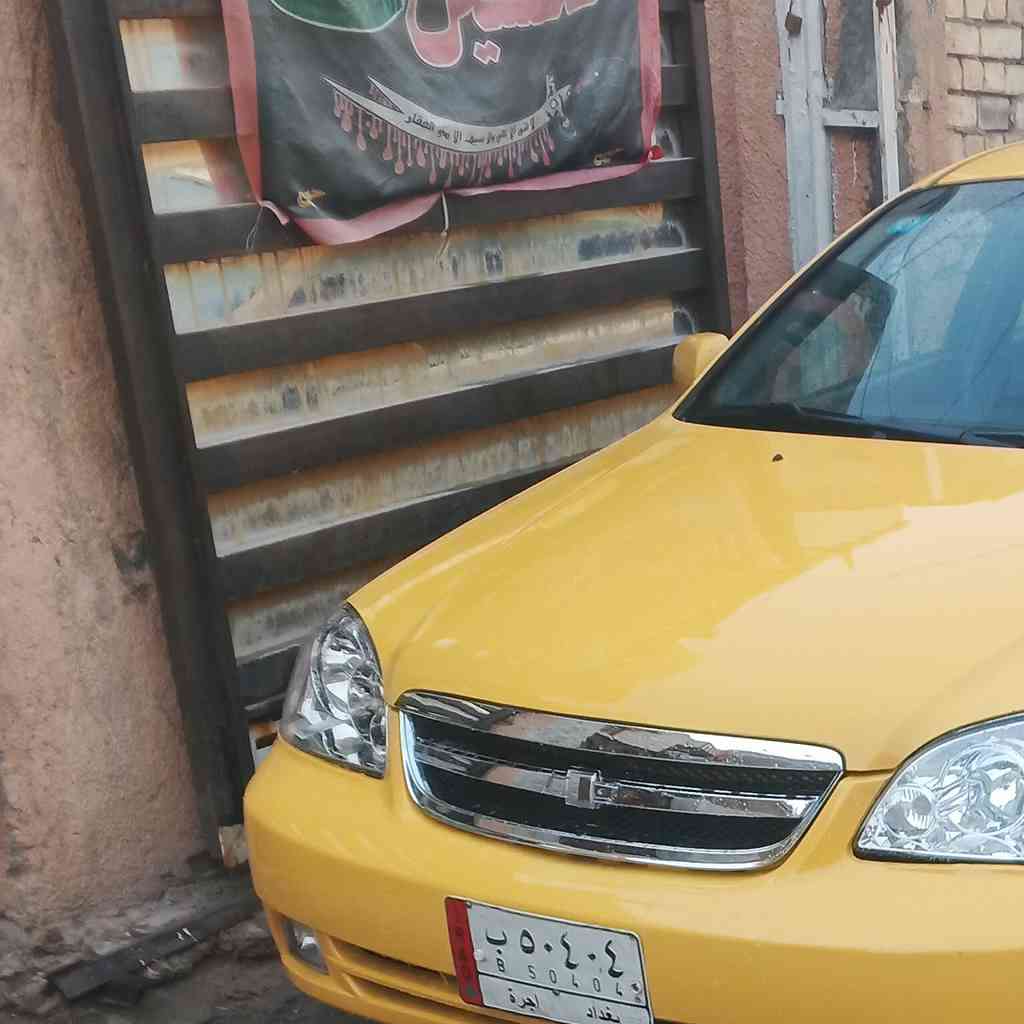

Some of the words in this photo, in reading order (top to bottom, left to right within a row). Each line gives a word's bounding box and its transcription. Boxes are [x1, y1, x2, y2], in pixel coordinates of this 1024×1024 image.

[519, 928, 624, 978] ٥٠٤٠٤
[496, 957, 506, 973] B
[527, 964, 623, 997] 50404
